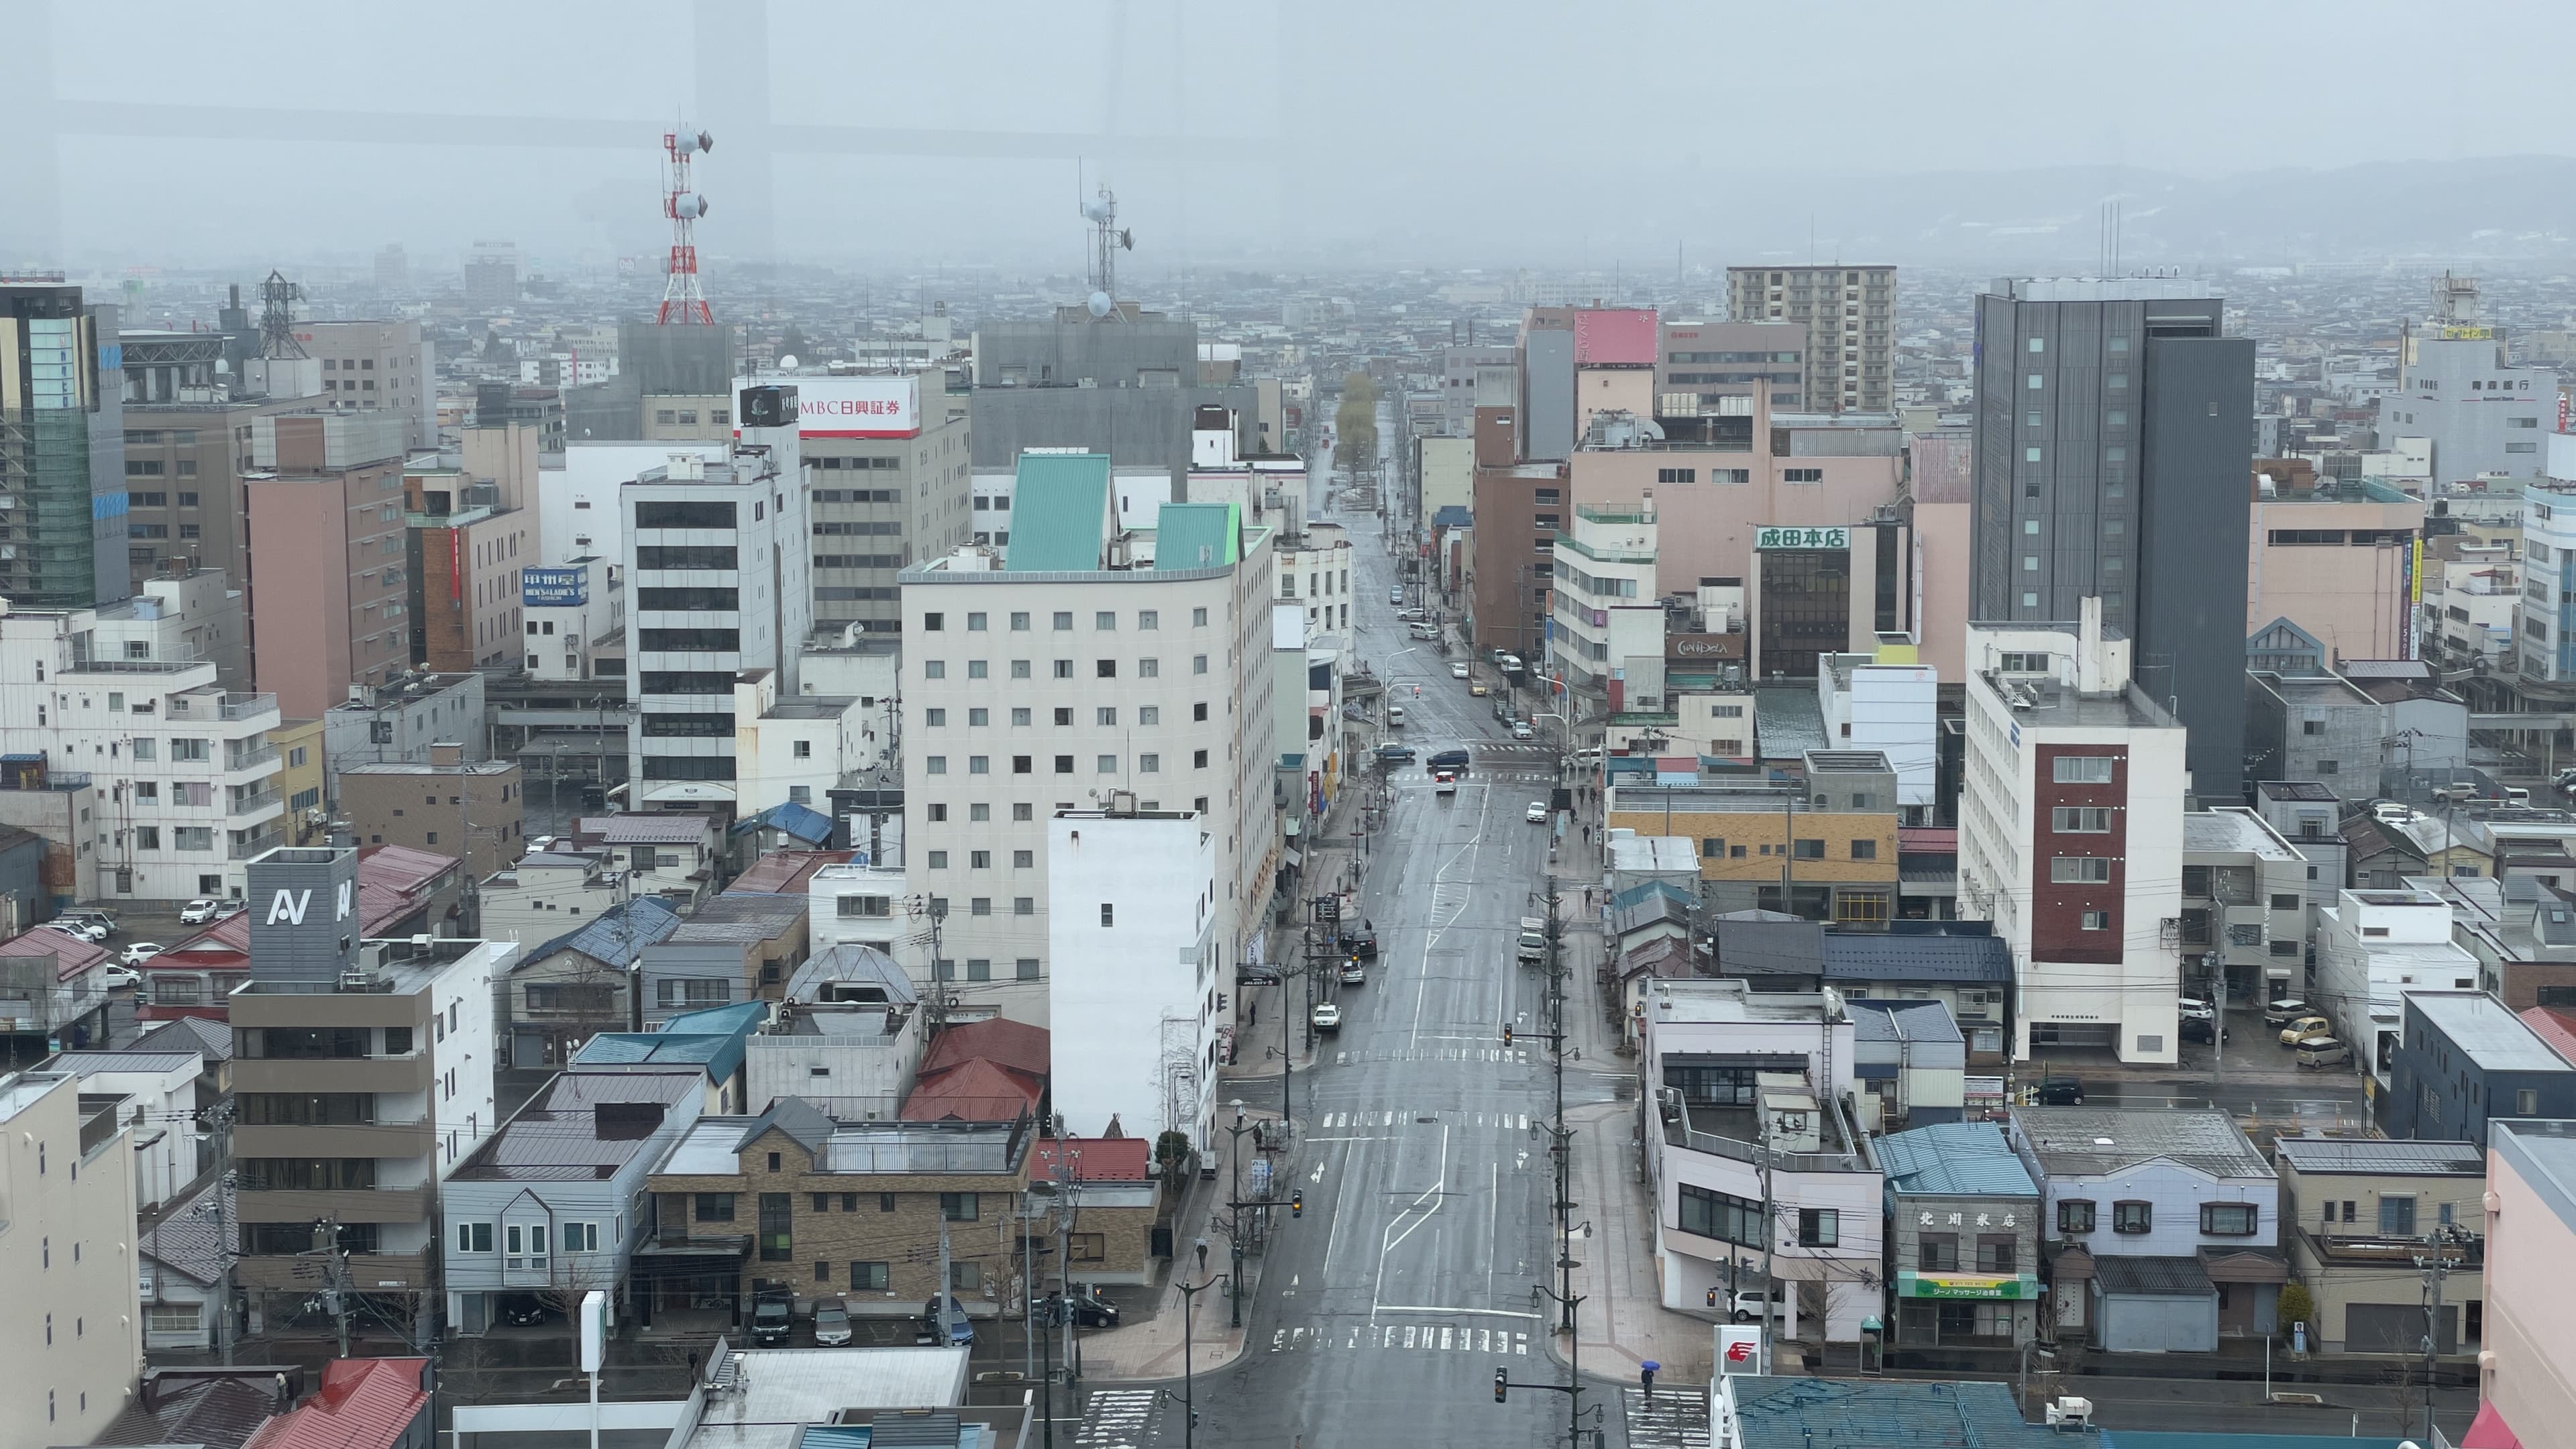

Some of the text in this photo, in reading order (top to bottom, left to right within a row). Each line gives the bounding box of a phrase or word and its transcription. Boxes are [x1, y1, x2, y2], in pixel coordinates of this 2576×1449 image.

[2472, 380, 2529, 390] 青森銀行
[800, 400, 900, 415] MBC日興証券
[1760, 529, 1845, 547] 成田本店
[266, 889, 312, 925] AV
